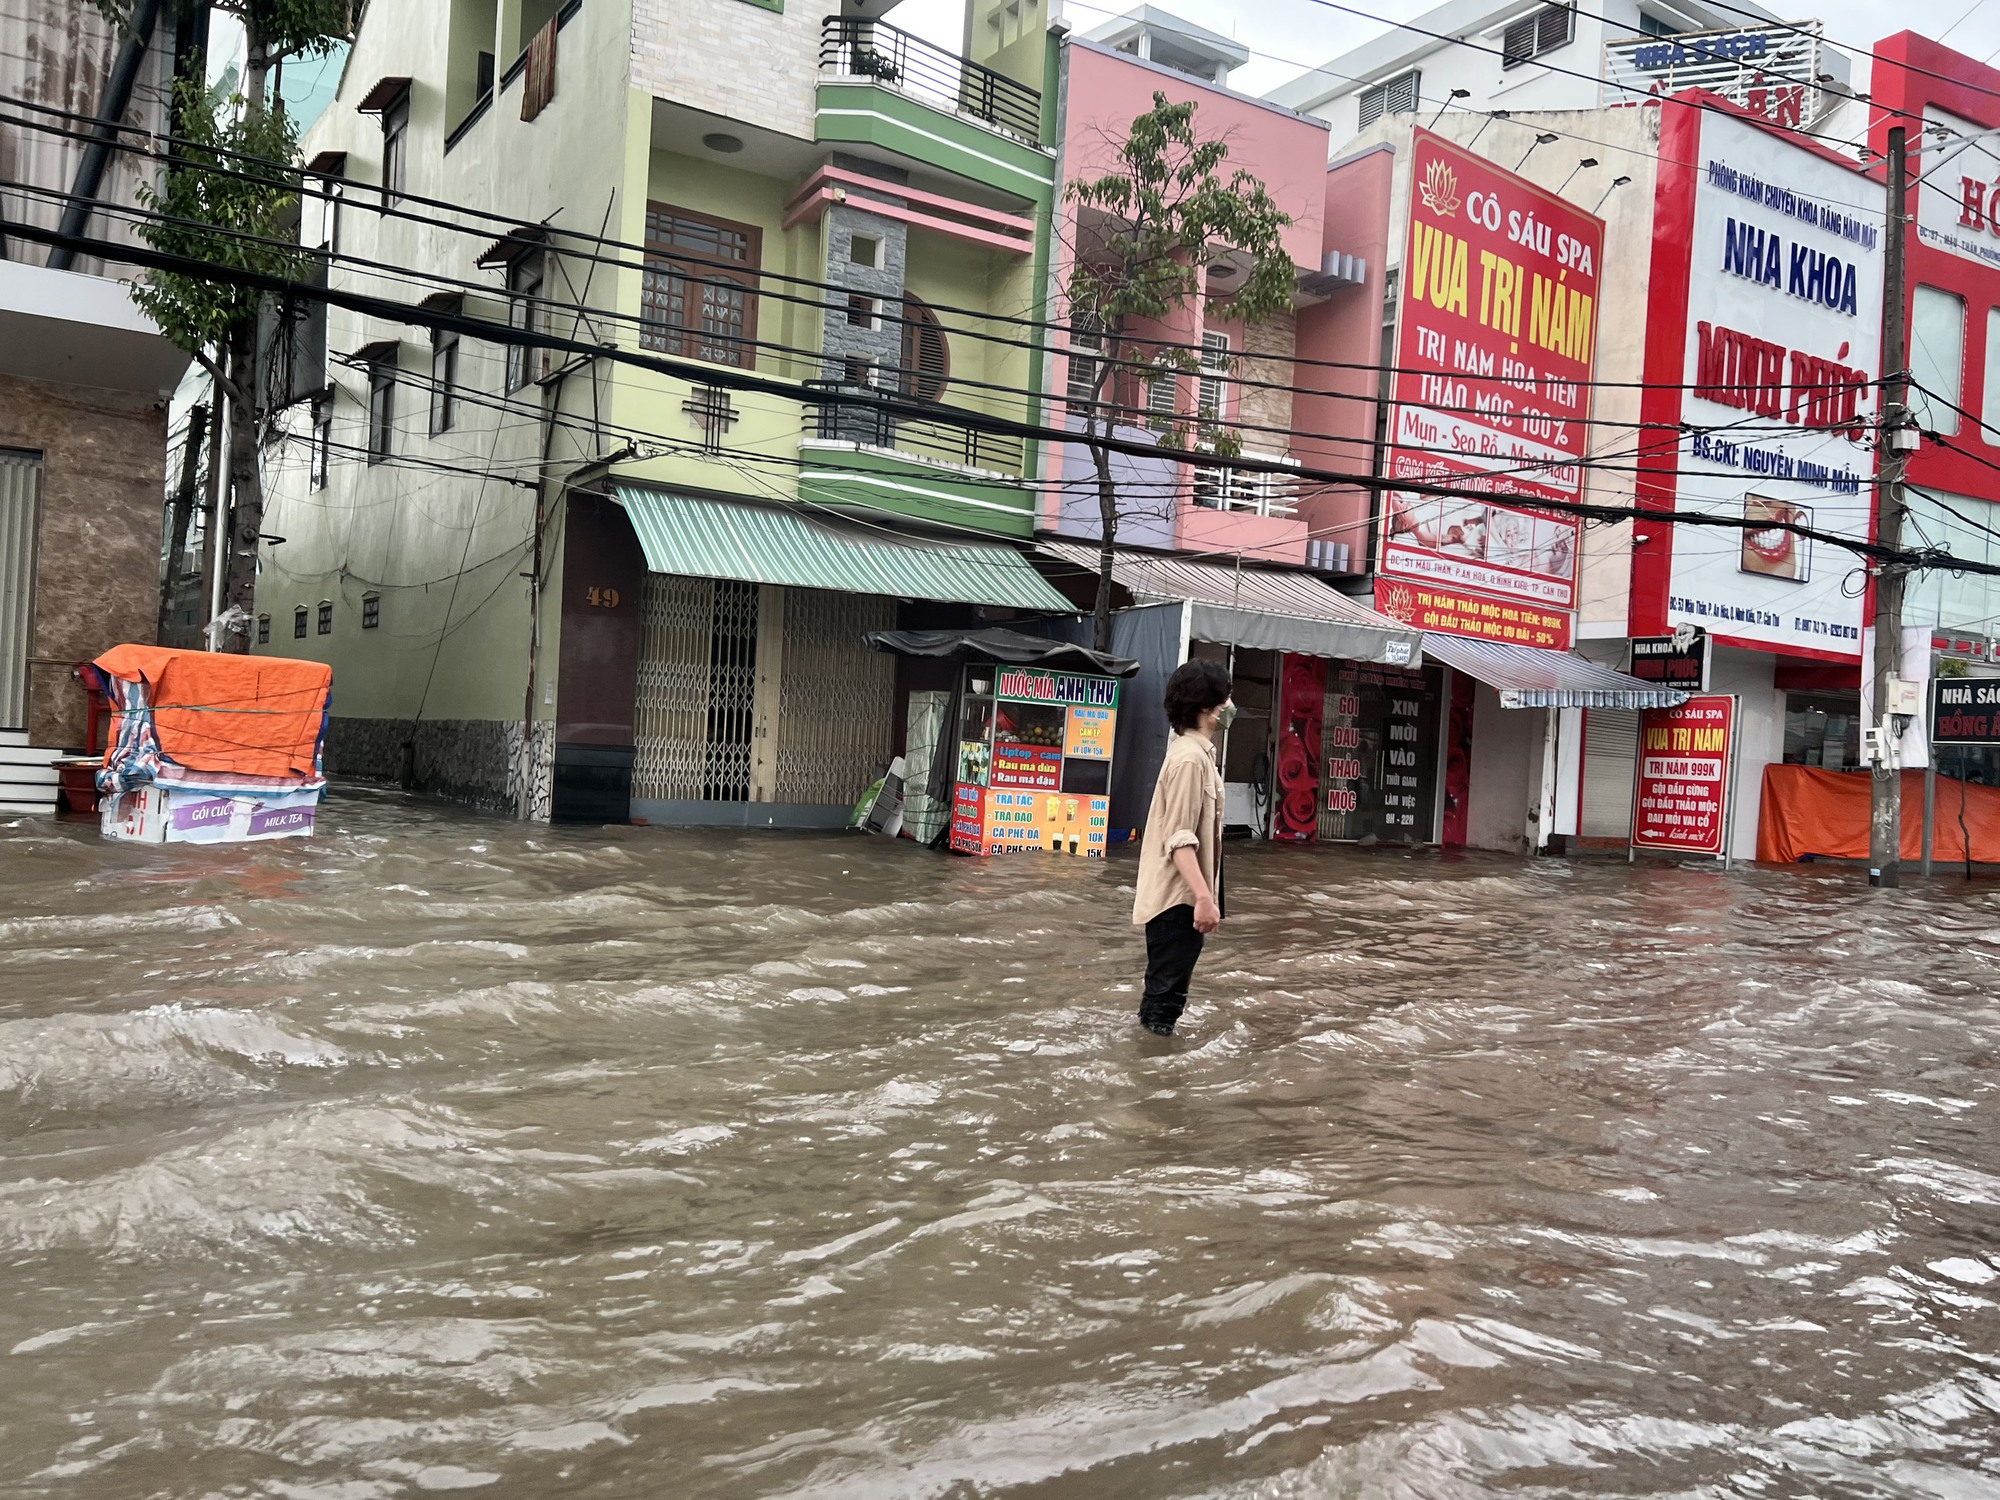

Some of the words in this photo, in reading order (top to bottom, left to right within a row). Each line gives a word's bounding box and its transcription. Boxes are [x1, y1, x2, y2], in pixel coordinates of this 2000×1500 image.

[1708, 159, 1737, 193] PHÒNG
[1739, 172, 1764, 203] KHÁM
[1765, 184, 1797, 217] CHUYÊN
[1797, 197, 1818, 226] KHOA
[1820, 205, 1841, 234] RĂNG
[1843, 213, 1860, 243] HÀM
[1466, 191, 1501, 231] CÔ
[1507, 211, 1551, 258] SÁU
[1557, 233, 1593, 277] SPA
[1724, 216, 1781, 290] NHA
[1788, 242, 1857, 317] KHOA
[1412, 220, 1468, 318] VUA
[1479, 249, 1524, 355] TRỊ
[1529, 269, 1592, 365] NÁM
[1417, 326, 1446, 367] TRỊ
[1454, 342, 1494, 379] NÁM
[1502, 357, 1537, 395] HOA
[1693, 320, 1786, 420] MINH
[1786, 341, 1868, 441] PHÚC
[1475, 390, 1514, 428] MỘC
[1521, 406, 1569, 446] 100%
[1404, 411, 1437, 447] Mụn
[1451, 425, 1476, 457] Sẹo
[1743, 445, 1794, 478] NGUYỄN
[1797, 459, 1828, 488] MINH
[586, 586, 619, 608] 49
[1417, 592, 1432, 609] TRỊ
[1434, 594, 1455, 611] NÁM
[1457, 597, 1480, 615] THẢO
[1481, 602, 1500, 619] MỘC
[1502, 607, 1518, 621] HOA
[1542, 615, 1562, 630] 999K
[1423, 612, 1439, 628] GỘI
[1460, 615, 1481, 632] THẢO
[1483, 620, 1502, 637] MỘC
[1536, 630, 1554, 645] 50%
[1635, 643, 1651, 655] NHA
[1652, 643, 1674, 654] KHOA
[1667, 655, 1699, 679] PHÚC
[1000, 669, 1033, 698] NƯỚC
[1033, 671, 1054, 700] MÍA
[1056, 676, 1085, 702] ANH
[1088, 679, 1117, 705] THƯ
[1942, 684, 1973, 704] NHÀ
[1338, 691, 1360, 719] GỘI
[1391, 699, 1419, 717] XIN
[1685, 708, 1703, 719] SÁU
[1706, 709, 1723, 719] SPA
[1389, 722, 1418, 743] MỜI
[1938, 708, 1987, 737] HỒNG
[1647, 728, 1668, 750] VUA
[1673, 727, 1691, 756] TRỊ
[1694, 723, 1724, 752] NÁM
[1000, 746, 1032, 760] Liptop
[1040, 752, 1061, 760] cam
[1389, 748, 1416, 767] VÀO
[998, 759, 1018, 771] Rau
[1020, 761, 1035, 772] má
[1328, 754, 1360, 780] THẢO
[1650, 761, 1663, 777] TRỊ
[1666, 759, 1688, 776] NÁM
[1691, 763, 1715, 777] 999K
[997, 772, 1017, 783] Rau
[1019, 775, 1034, 785] má
[1401, 776, 1417, 788] GIAN
[1653, 783, 1666, 797] GỘI
[1016, 792, 1034, 806] TÁC
[1091, 800, 1107, 811] 10K
[1328, 787, 1357, 815] MỘC
[1642, 797, 1655, 811] GỘI
[1676, 797, 1696, 812] THẢO
[1698, 801, 1718, 816] MỘC
[192, 805, 209, 820] GỎI
[264, 815, 287, 828] MILK
[289, 813, 303, 824] TEA
[1090, 816, 1105, 827] 10K
[1385, 812, 1395, 825] 9H
[1400, 812, 1414, 826] 22H
[1647, 813, 1663, 824] ĐAU
[1683, 815, 1696, 826] VAI
[1088, 832, 1104, 843] 10K
[1087, 848, 1102, 858] 15K
